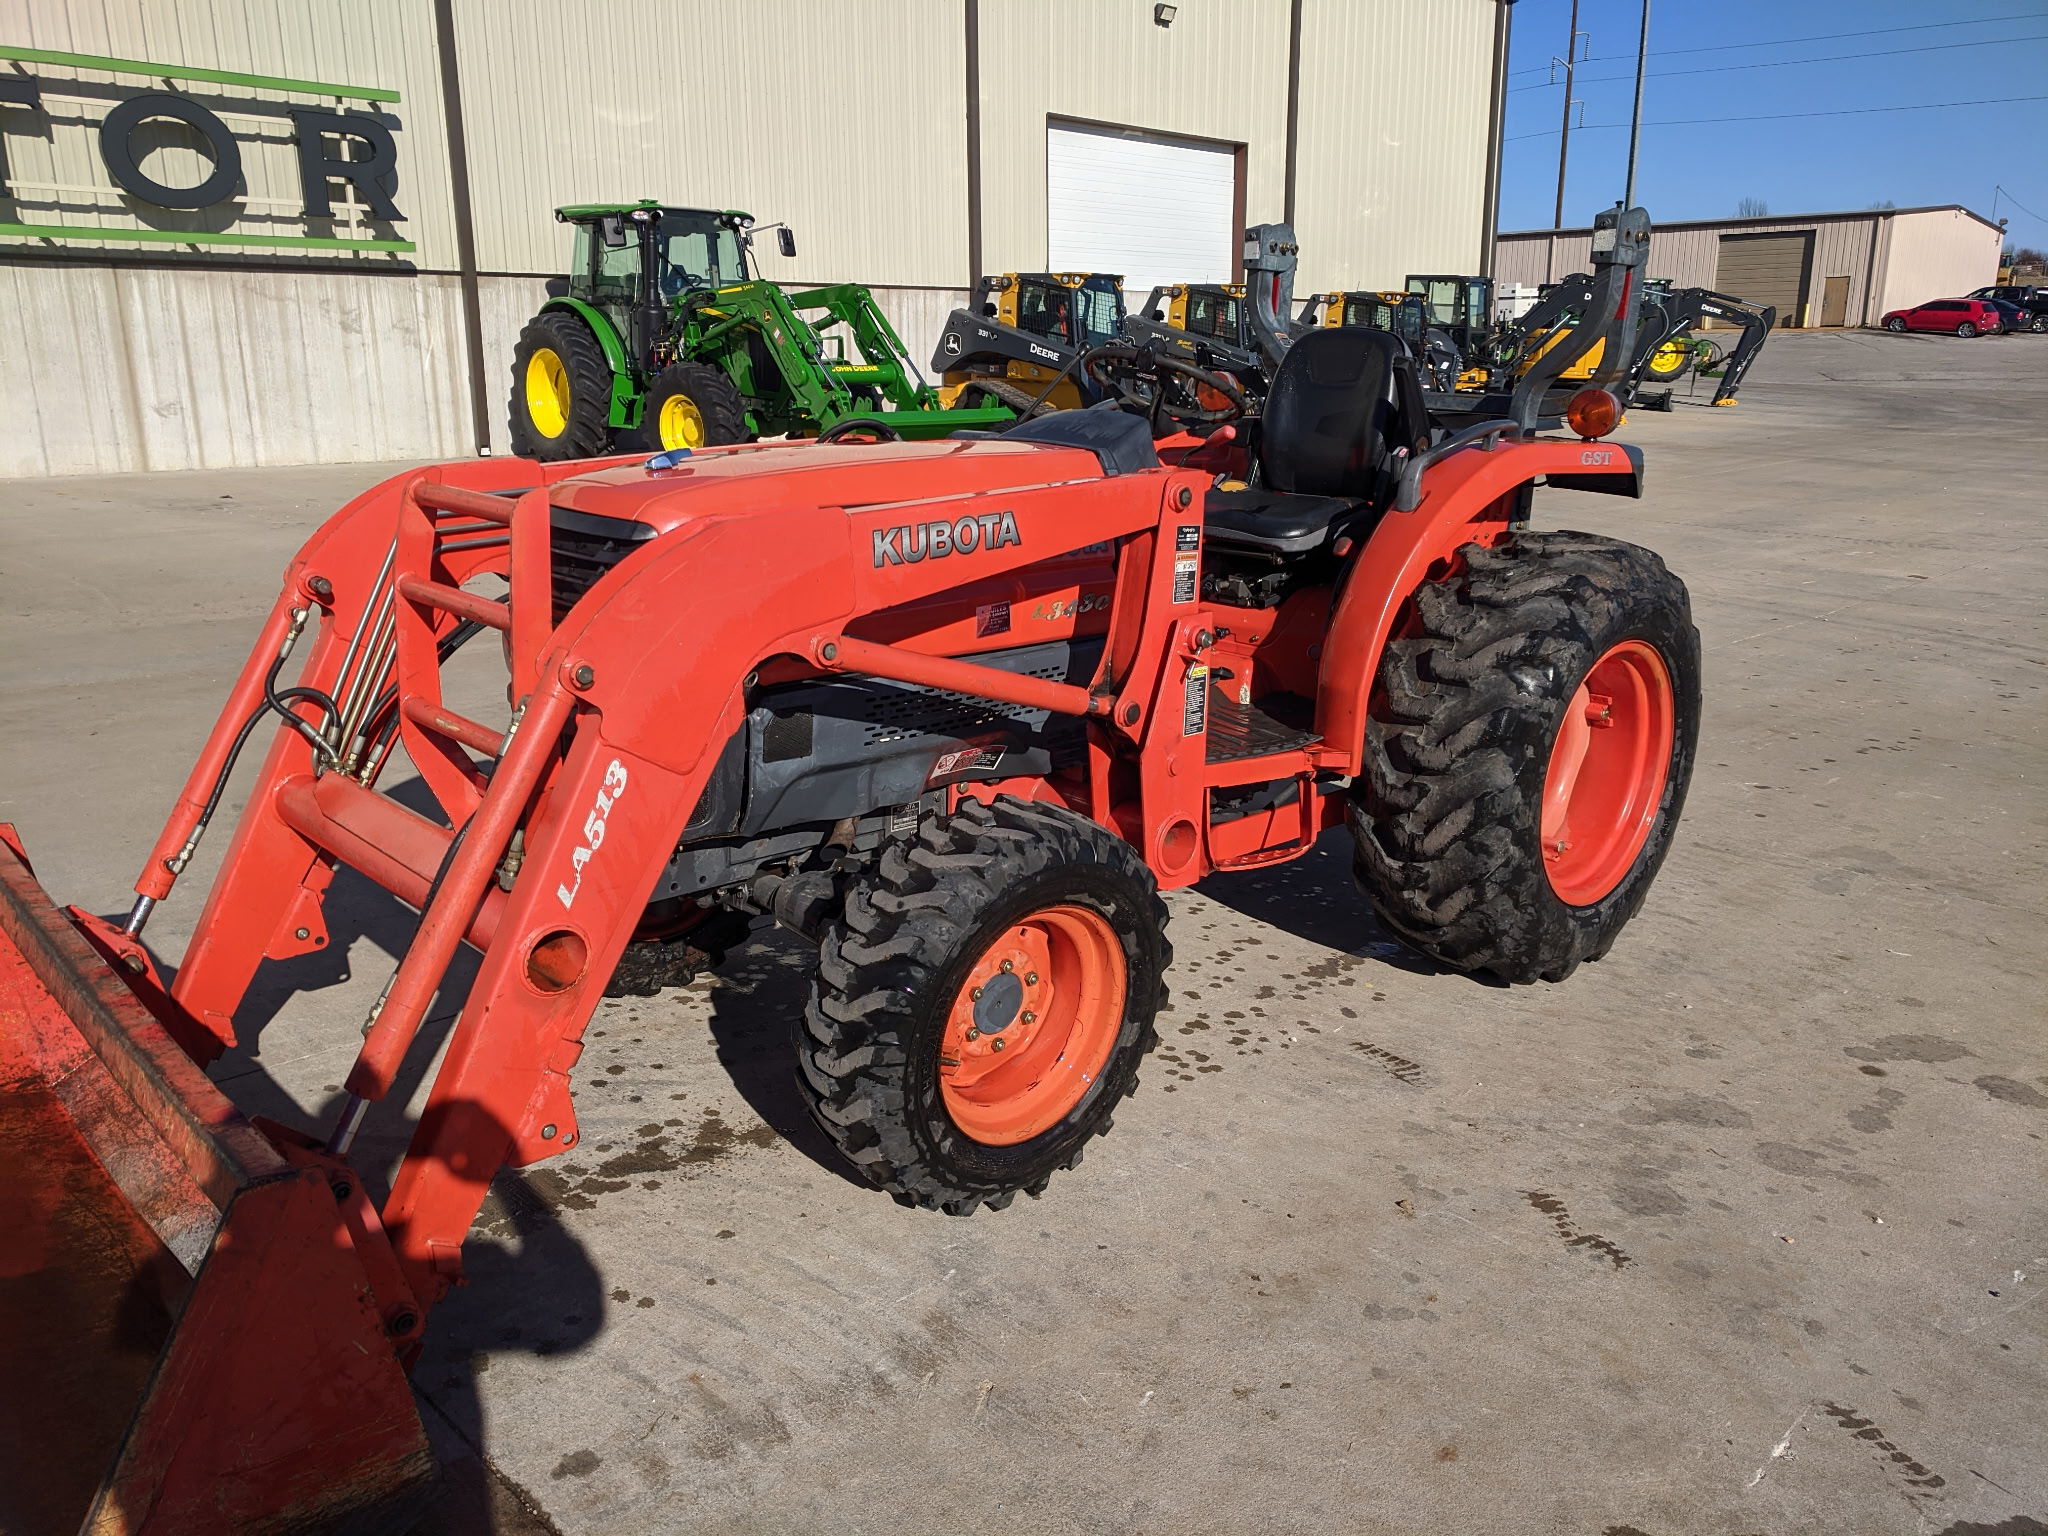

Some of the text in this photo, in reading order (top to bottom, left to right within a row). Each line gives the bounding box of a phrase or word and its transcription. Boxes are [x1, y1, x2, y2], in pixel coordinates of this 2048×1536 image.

[1029, 342, 1060, 362] DEERE
[1581, 451, 1612, 466] GST
[873, 511, 1022, 568] KUBOTA
[556, 758, 628, 909] LA513
